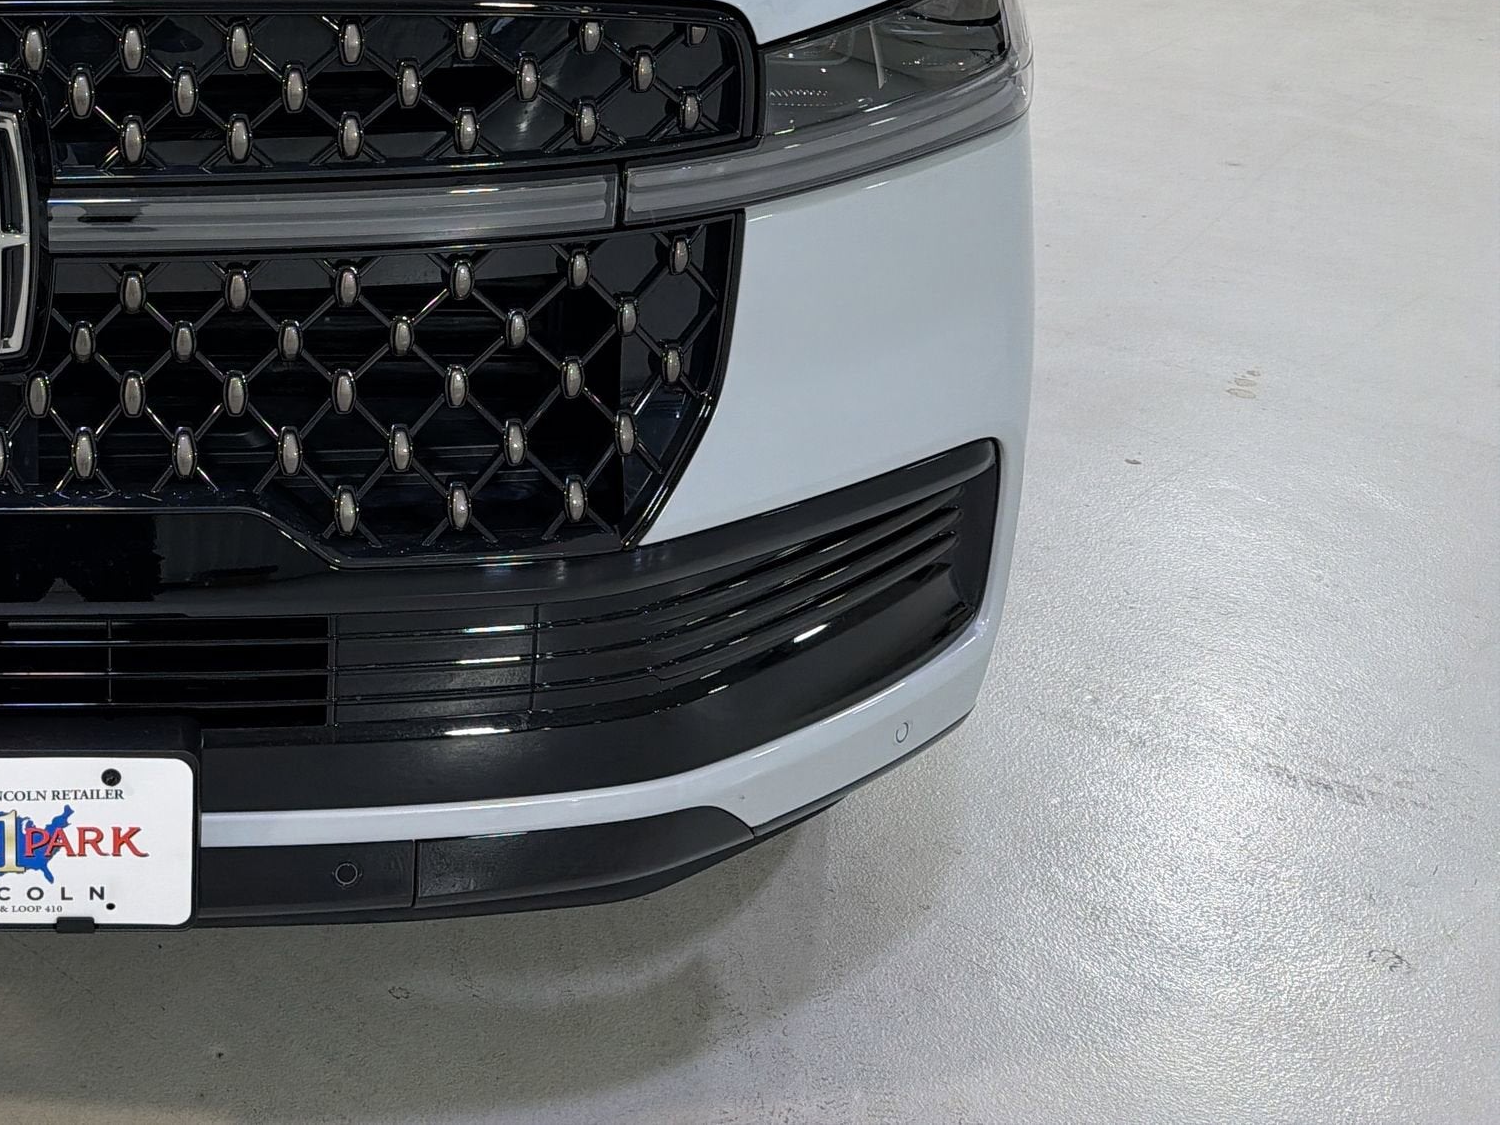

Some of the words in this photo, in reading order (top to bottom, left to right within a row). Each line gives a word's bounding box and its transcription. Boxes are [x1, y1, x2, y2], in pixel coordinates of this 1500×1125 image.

[51, 789, 124, 800] RETAILER
[25, 826, 150, 858] PARK
[0, 905, 8, 913] &
[11, 905, 42, 913] LOOP
[45, 905, 63, 913] 410
